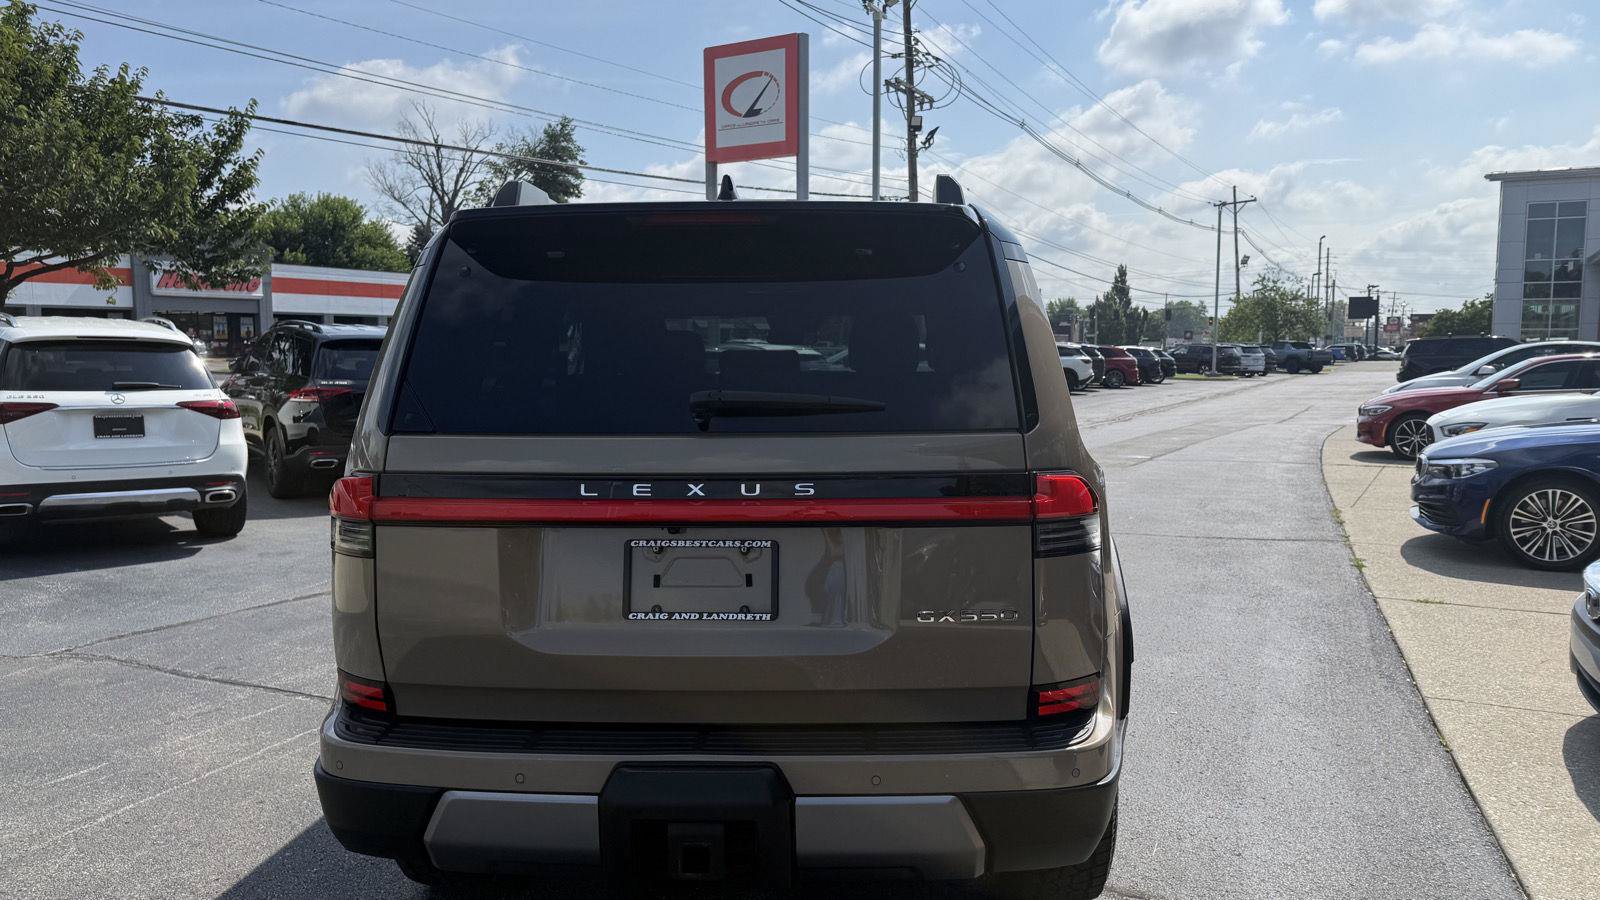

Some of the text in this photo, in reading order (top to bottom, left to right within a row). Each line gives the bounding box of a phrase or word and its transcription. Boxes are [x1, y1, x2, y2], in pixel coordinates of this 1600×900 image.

[580, 483, 815, 497] LEXUS
[630, 540, 772, 548] CRAIGSBESTCARS.COM
[628, 612, 772, 621] CRAIG AND LANDRETH
